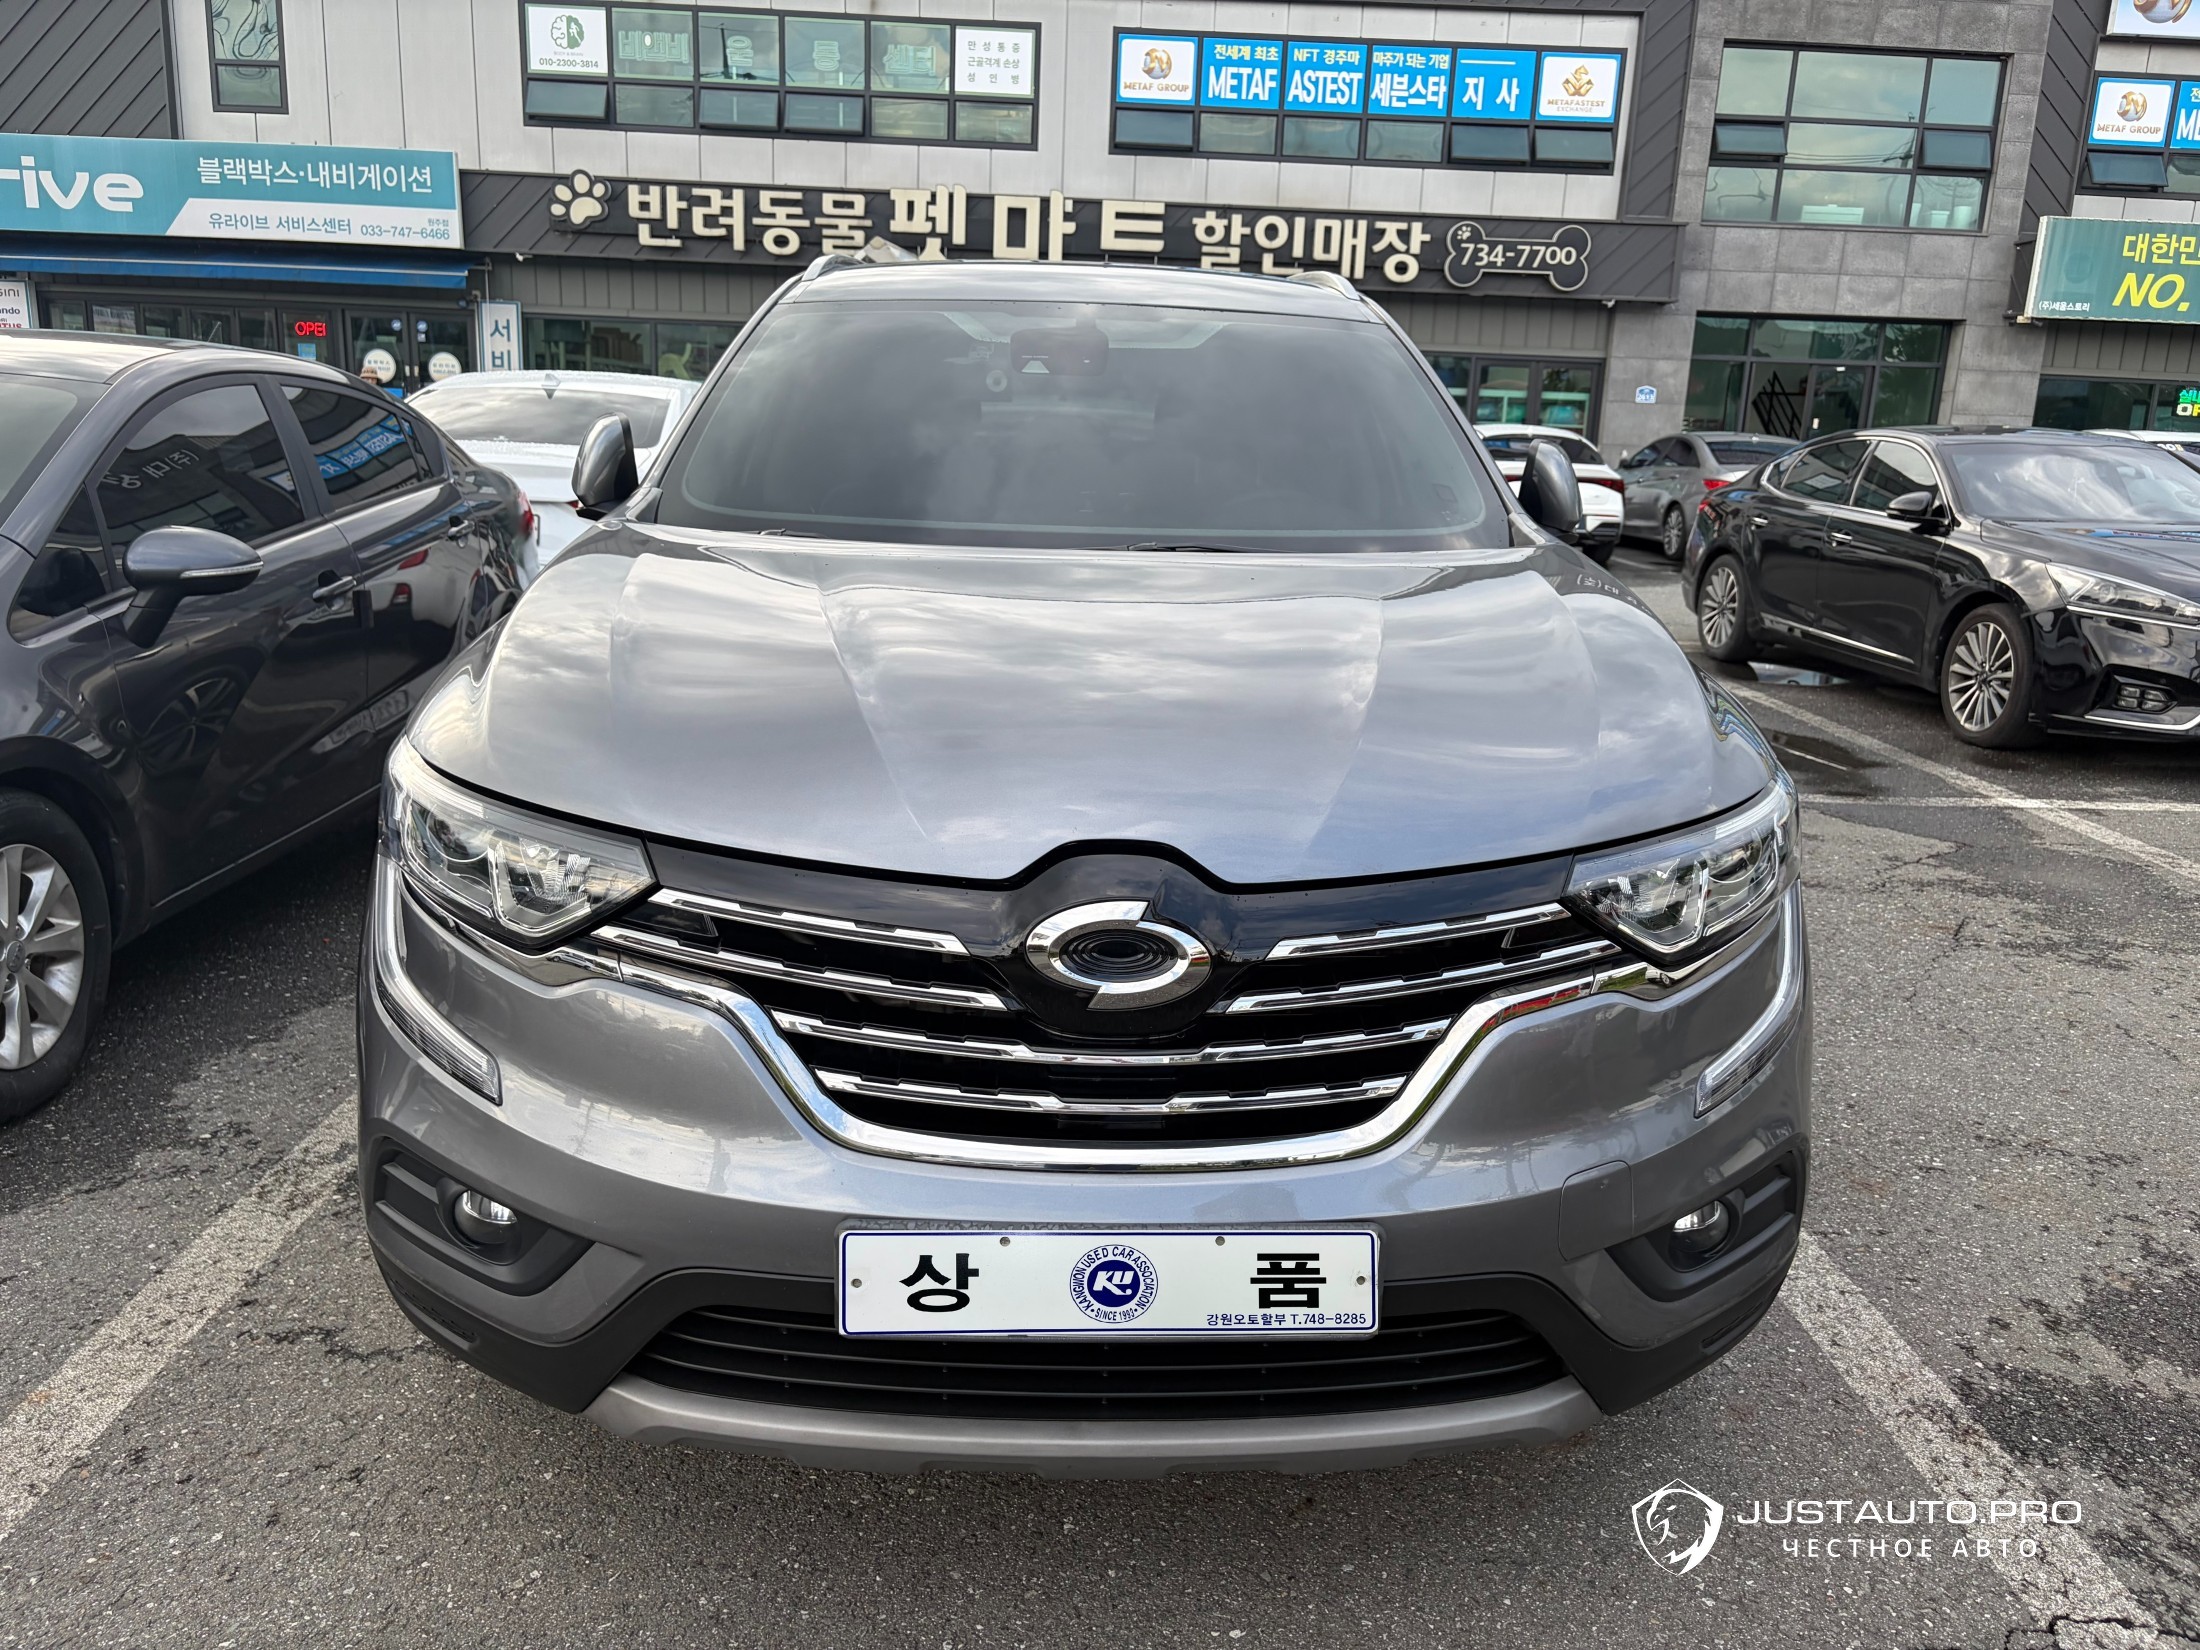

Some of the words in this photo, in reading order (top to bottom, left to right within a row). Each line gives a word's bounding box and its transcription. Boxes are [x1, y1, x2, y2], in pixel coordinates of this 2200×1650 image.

[1214, 44, 1251, 60] 전세계
[1254, 46, 1279, 61] 최초
[1293, 48, 1319, 62] NFT
[1323, 50, 1360, 65] 경주마
[539, 57, 599, 68] 010-2300-3814
[1123, 81, 1153, 91] METAF
[1157, 83, 1189, 92] GROUP
[1208, 65, 1277, 101] METAF
[1287, 69, 1363, 105] ASTEST
[1370, 73, 1446, 109] 세븐스타
[2097, 124, 2126, 133] METAF
[2129, 125, 2161, 135] GROUP
[209, 212, 270, 231] 유라이브
[276, 215, 351, 235] 서비스센터
[360, 224, 450, 240] 033-747-6466
[628, 184, 873, 255] 반려동물
[1192, 211, 1431, 283] 할인매장
[1460, 243, 1577, 268] 734-7700
[1081, 1247, 1109, 1268] USED
[1112, 1246, 1134, 1260] CAR
[900, 1253, 979, 1312] 상
[1250, 1253, 1327, 1308] 품
[1073, 1266, 1094, 1311] KANGWON
[1131, 1255, 1155, 1310] ASSOCIATION
[1095, 1308, 1117, 1321] SINCE
[1119, 1308, 1135, 1320] 1993
[1207, 1314, 1286, 1325] 강원오토할부
[1290, 1313, 1367, 1325] T.748-8285
